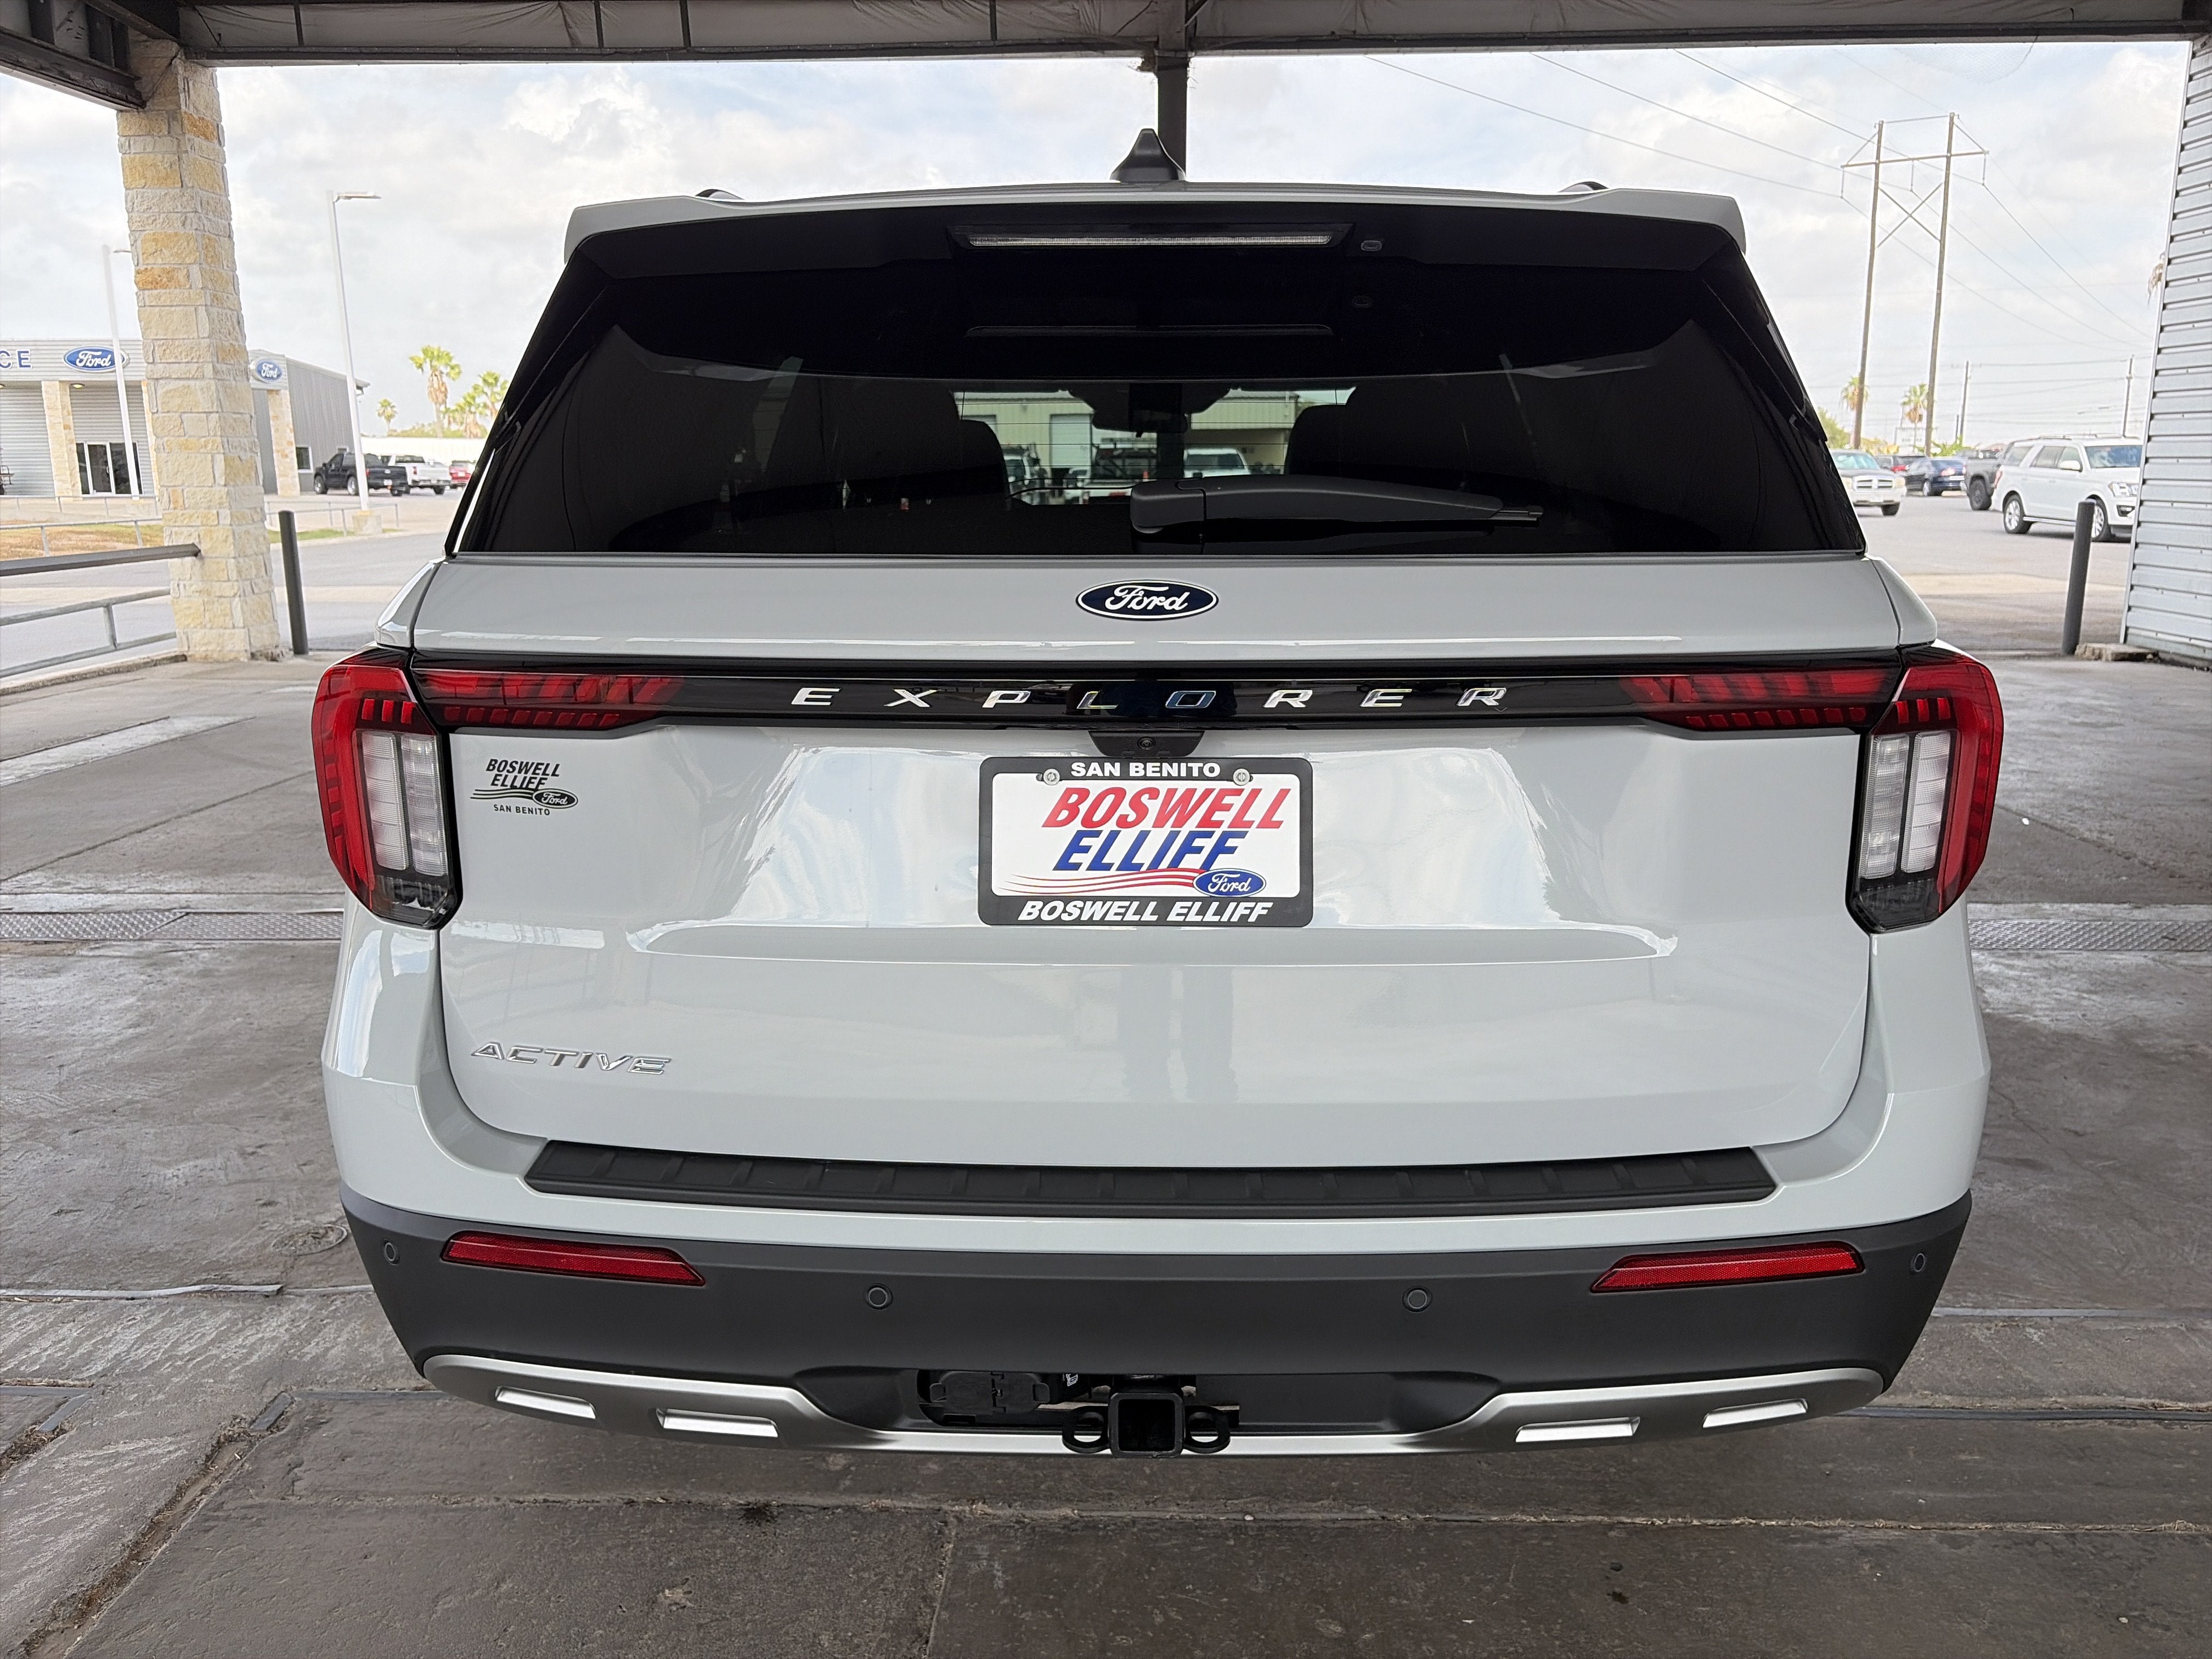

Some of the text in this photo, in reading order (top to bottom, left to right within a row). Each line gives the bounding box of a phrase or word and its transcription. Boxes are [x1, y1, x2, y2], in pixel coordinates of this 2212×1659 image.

[76, 350, 112, 367] Ford
[261, 362, 278, 378] Ford
[1105, 585, 1190, 610] Ford
[791, 687, 1507, 709] EXPLORER
[486, 759, 560, 777] BOSWELL
[1070, 761, 1221, 777] SAN BENITO
[490, 774, 548, 789] ELLIFF
[541, 792, 568, 805] Ford
[1041, 787, 1292, 829] BOSWELL
[494, 804, 550, 816] SAN BENITO
[1052, 830, 1251, 871] ELLIFF
[1207, 873, 1251, 893] Ford
[1017, 900, 1274, 923] BOSWELL ELLIFF
[471, 1042, 672, 1075] ACTIVE
